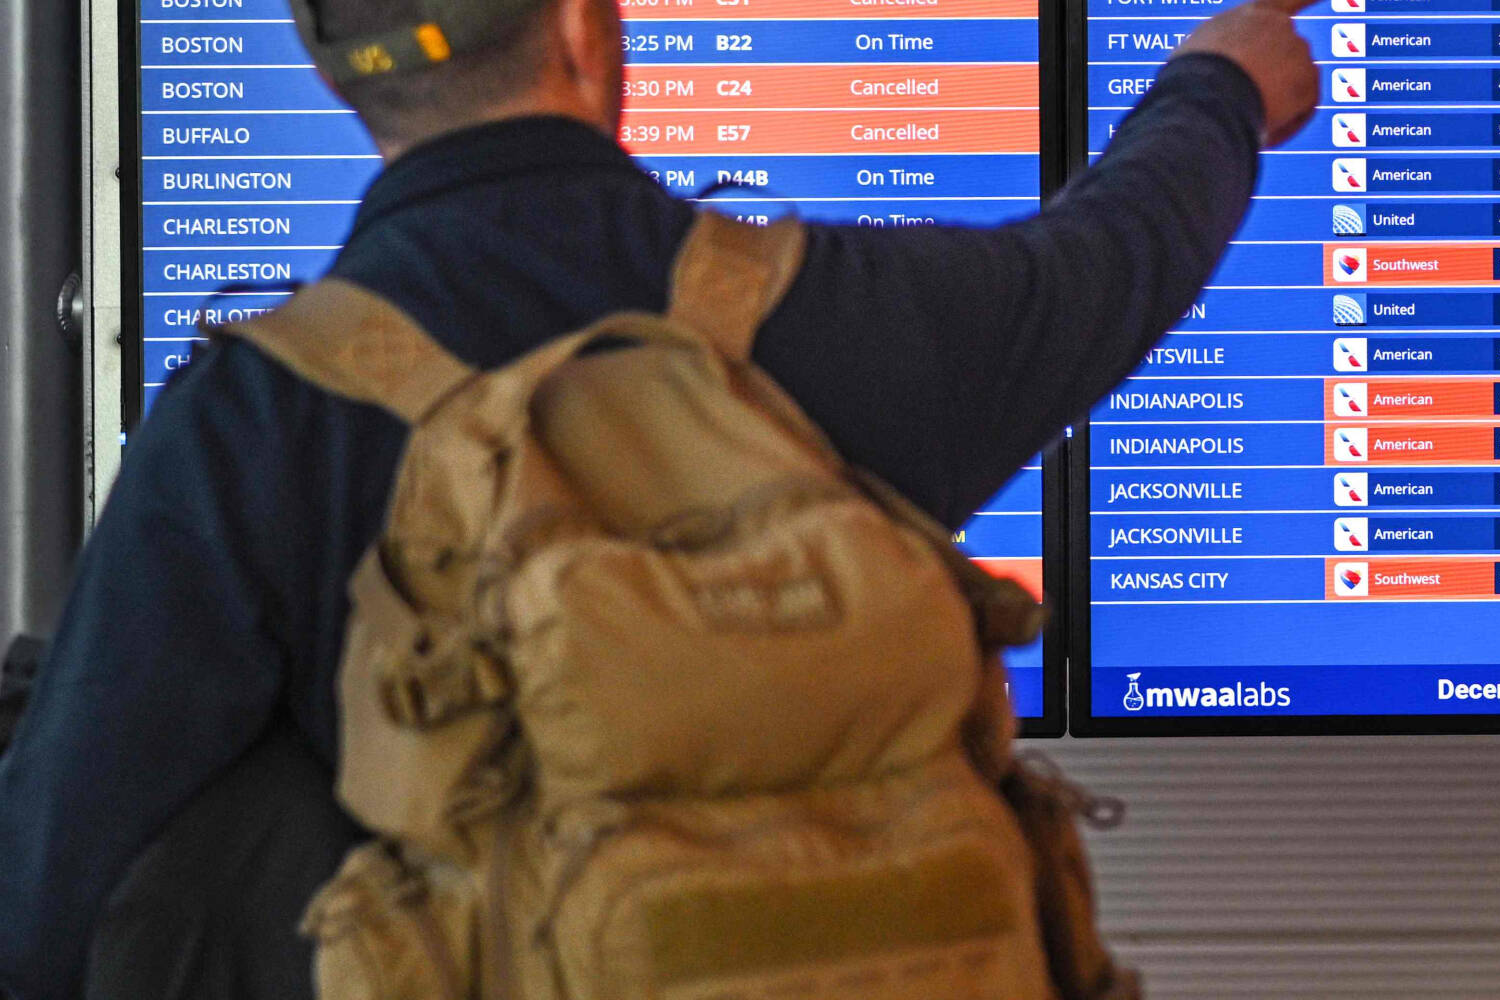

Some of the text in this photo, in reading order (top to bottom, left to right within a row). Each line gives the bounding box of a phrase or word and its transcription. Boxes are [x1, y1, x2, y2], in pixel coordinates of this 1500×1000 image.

[162, 127, 250, 145] BUFFALO
[665, 125, 694, 142] PM
[717, 124, 751, 142] E57
[850, 123, 940, 141] Cancelled
[163, 172, 292, 190] BURLINGTON
[1373, 213, 1415, 226] United
[1107, 482, 1243, 504] JACKSONVILLE
[1373, 482, 1434, 495] American
[1146, 681, 1291, 708] mwaalabs
